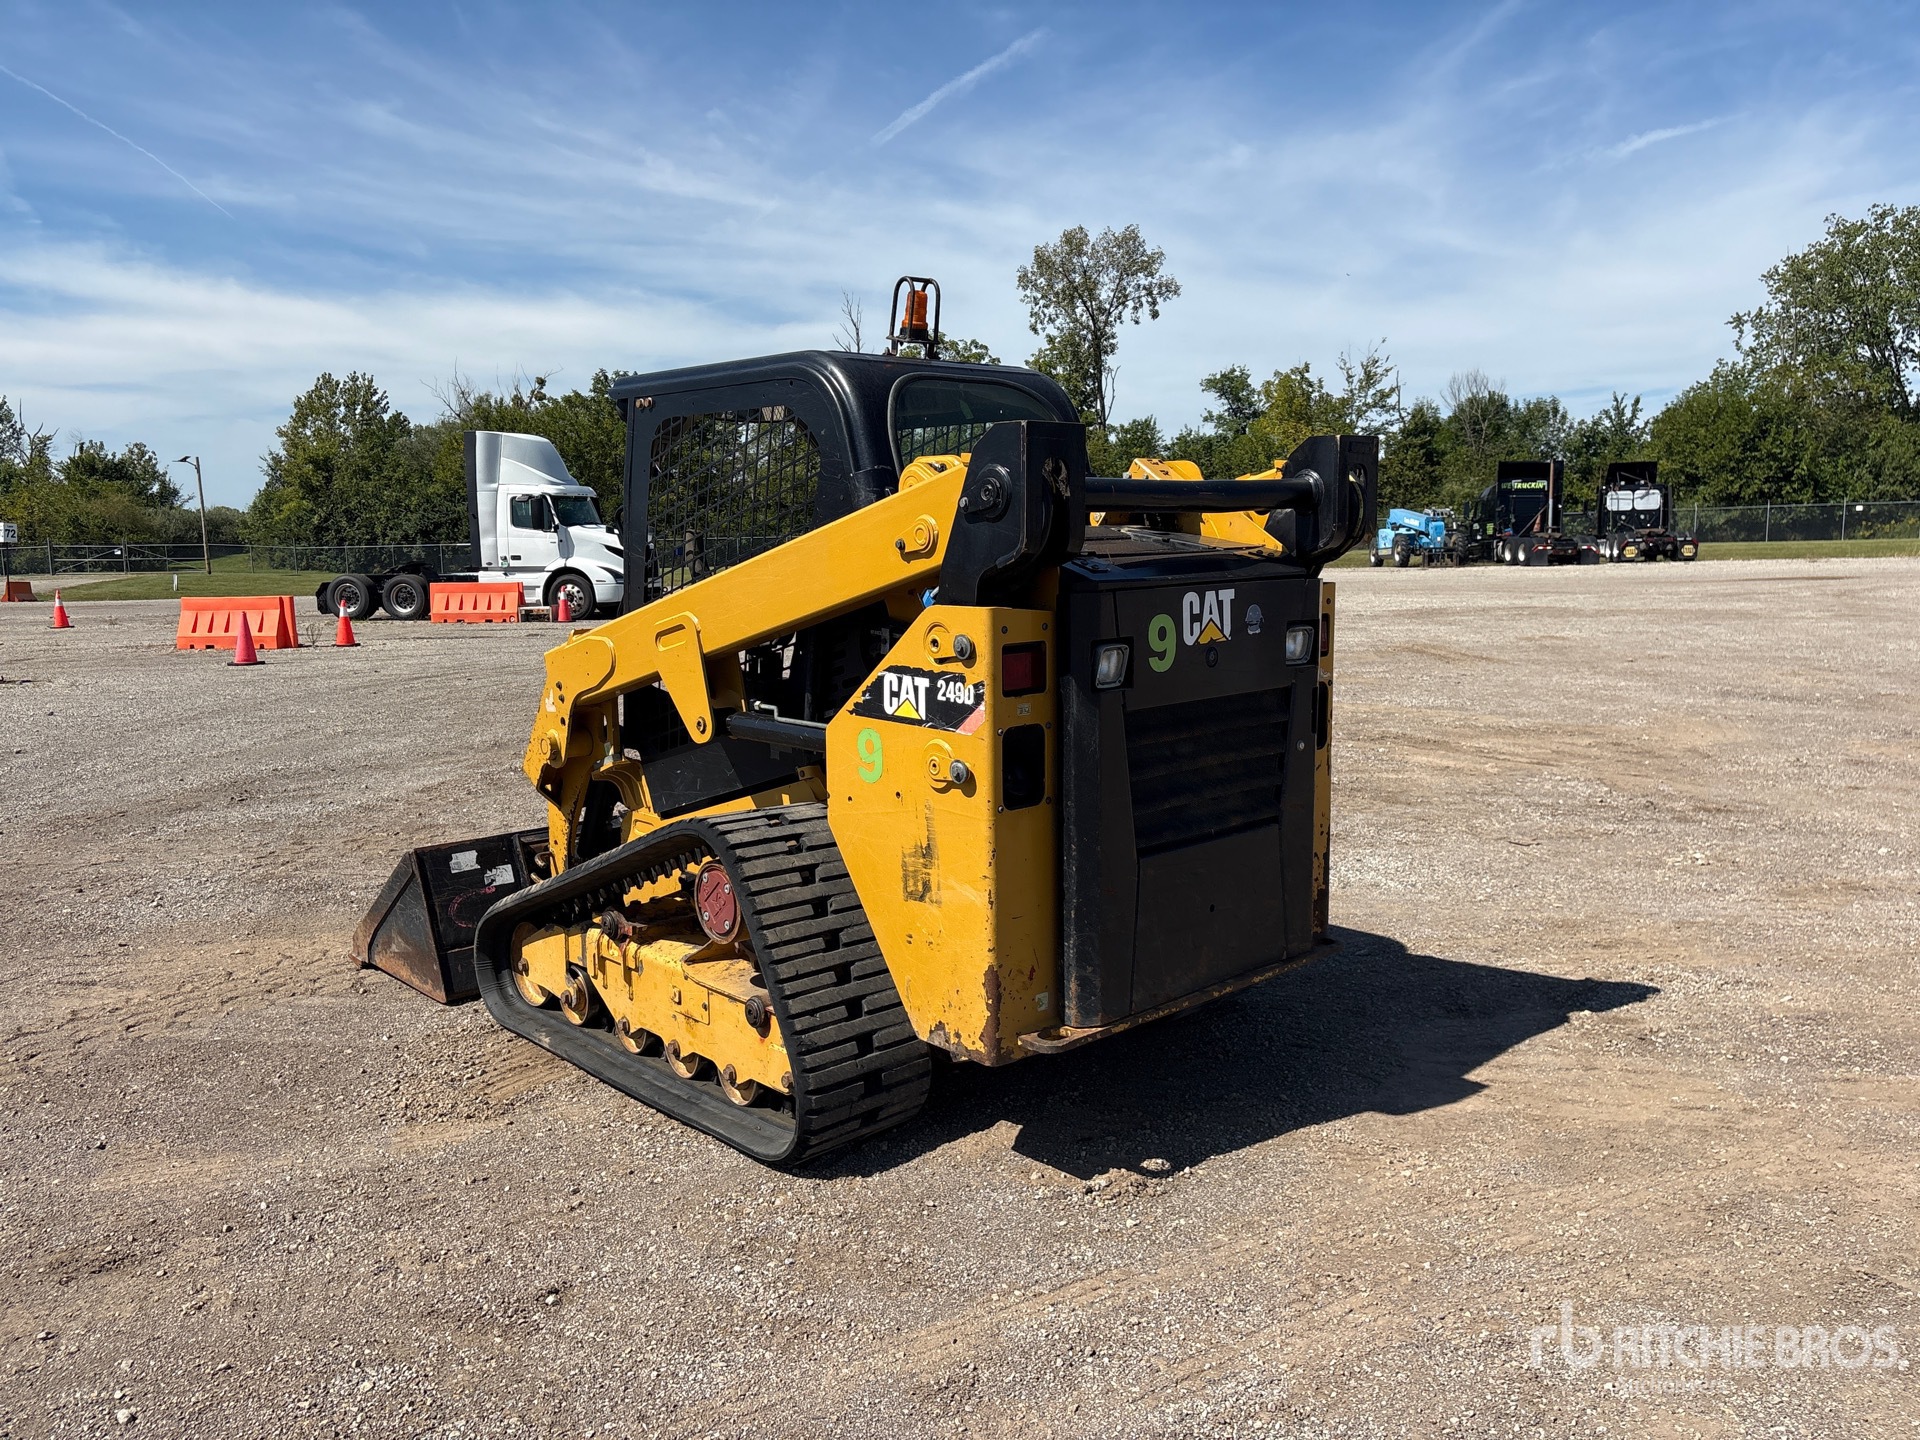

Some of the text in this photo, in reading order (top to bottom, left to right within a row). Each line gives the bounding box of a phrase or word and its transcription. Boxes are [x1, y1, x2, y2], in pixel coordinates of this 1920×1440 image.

[5, 529, 16, 538] 72
[1148, 613, 1177, 673] 9
[1183, 588, 1235, 646] CAT
[884, 673, 930, 720] CAT
[857, 728, 883, 784] 9
